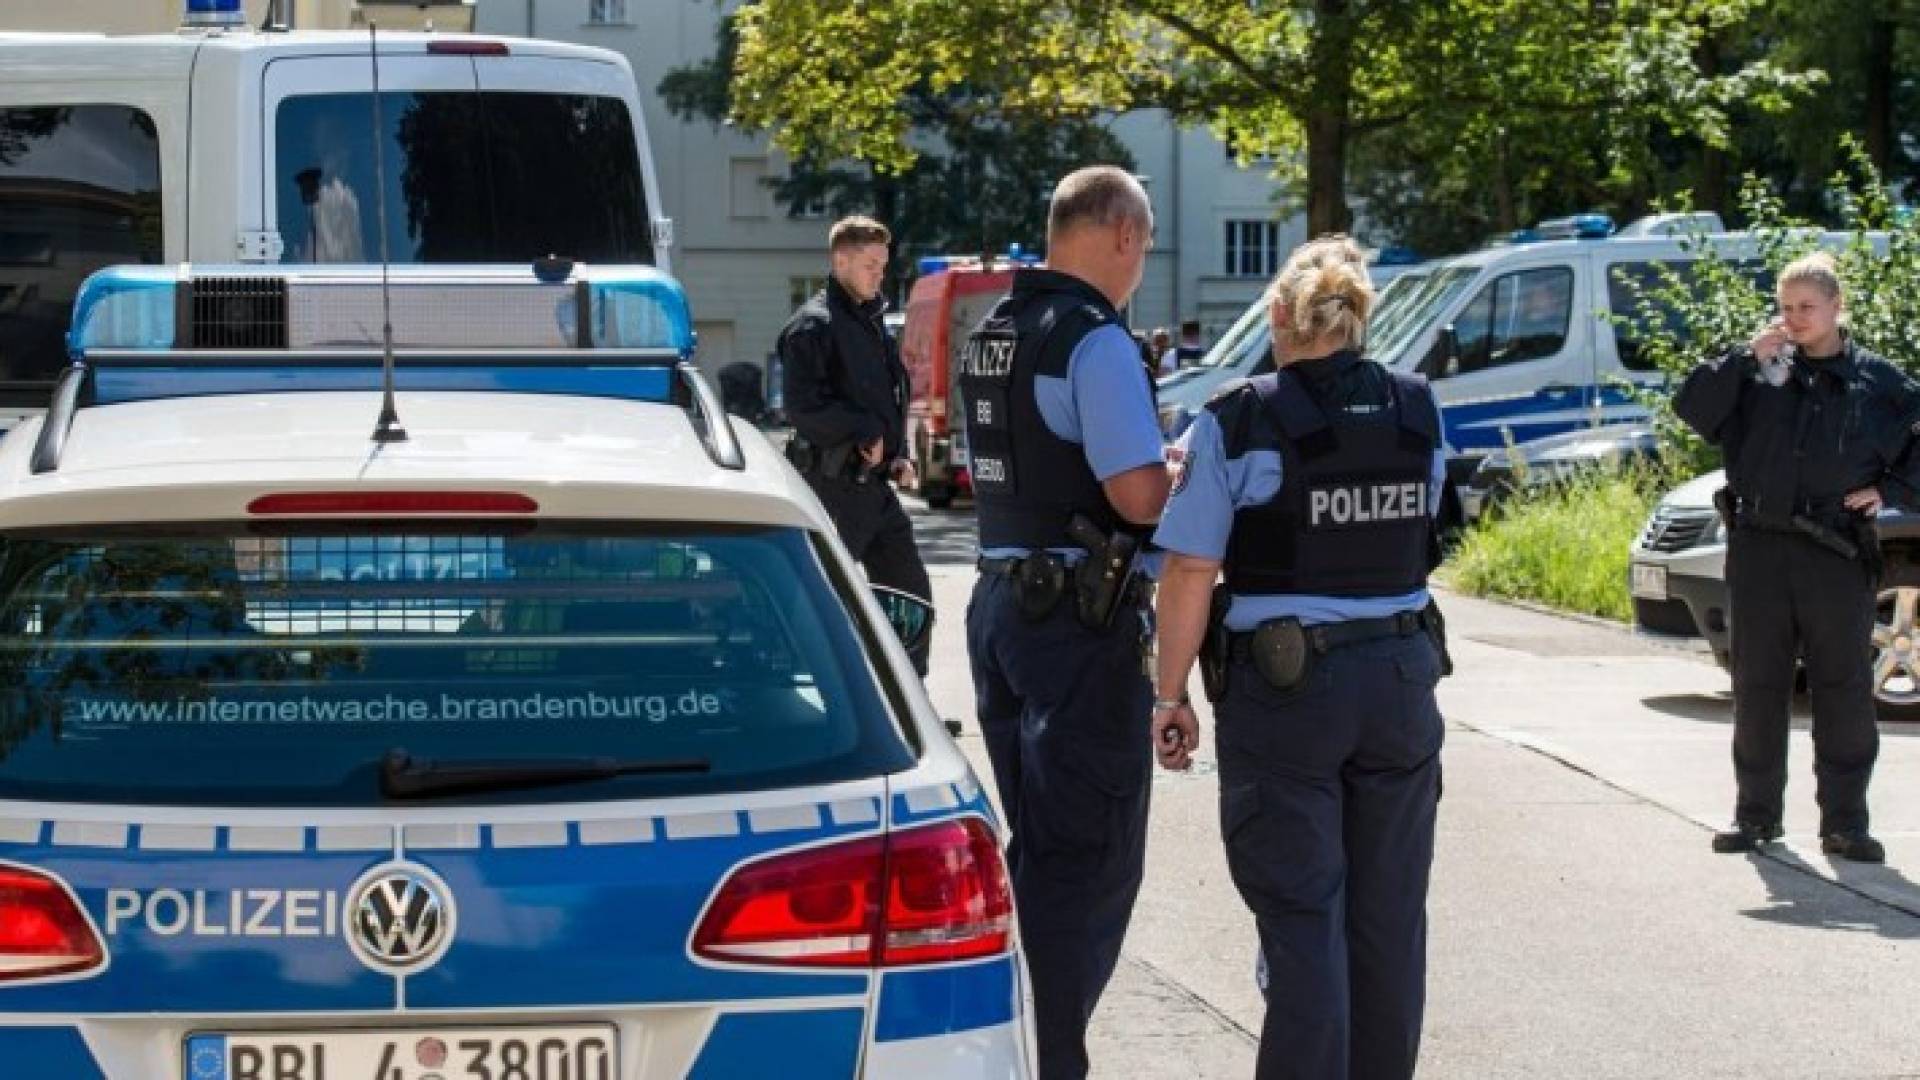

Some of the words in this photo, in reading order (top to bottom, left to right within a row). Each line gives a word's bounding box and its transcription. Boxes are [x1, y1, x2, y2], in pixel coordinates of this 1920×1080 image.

[1310, 482, 1427, 525] POLIZEI
[79, 688, 720, 723] www.internetwache.brandenburg.de
[105, 888, 338, 936] POLIZEI
[459, 1036, 609, 1080] 3800
